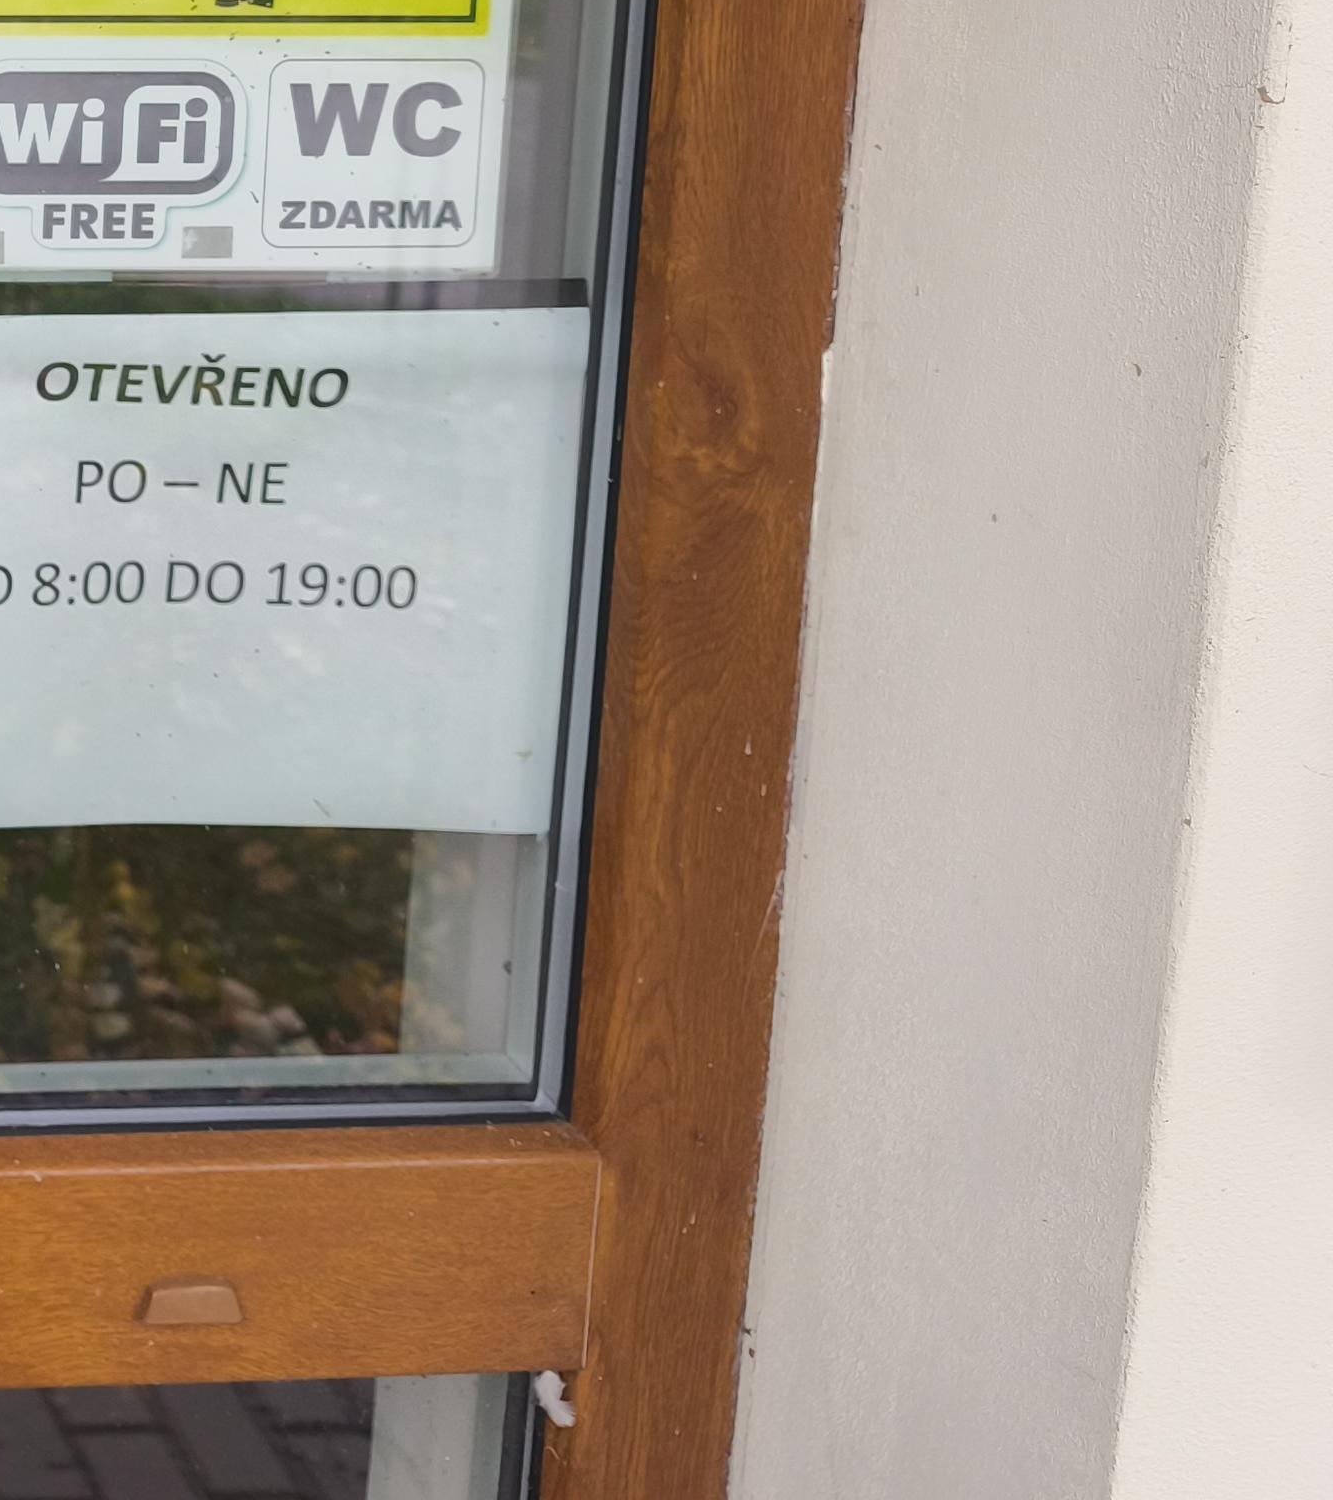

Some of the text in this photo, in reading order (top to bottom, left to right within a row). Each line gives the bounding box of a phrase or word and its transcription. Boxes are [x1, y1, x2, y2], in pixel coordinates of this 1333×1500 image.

[291, 81, 463, 159] WC
[42, 203, 157, 241] FREE
[279, 200, 463, 231] ZDARMA
[37, 353, 350, 409] OTEVŘENO
[75, 461, 146, 504] PO
[217, 463, 289, 505] NE
[31, 561, 146, 606] 8:00
[165, 561, 246, 606] DO
[265, 562, 418, 610] 19:00
